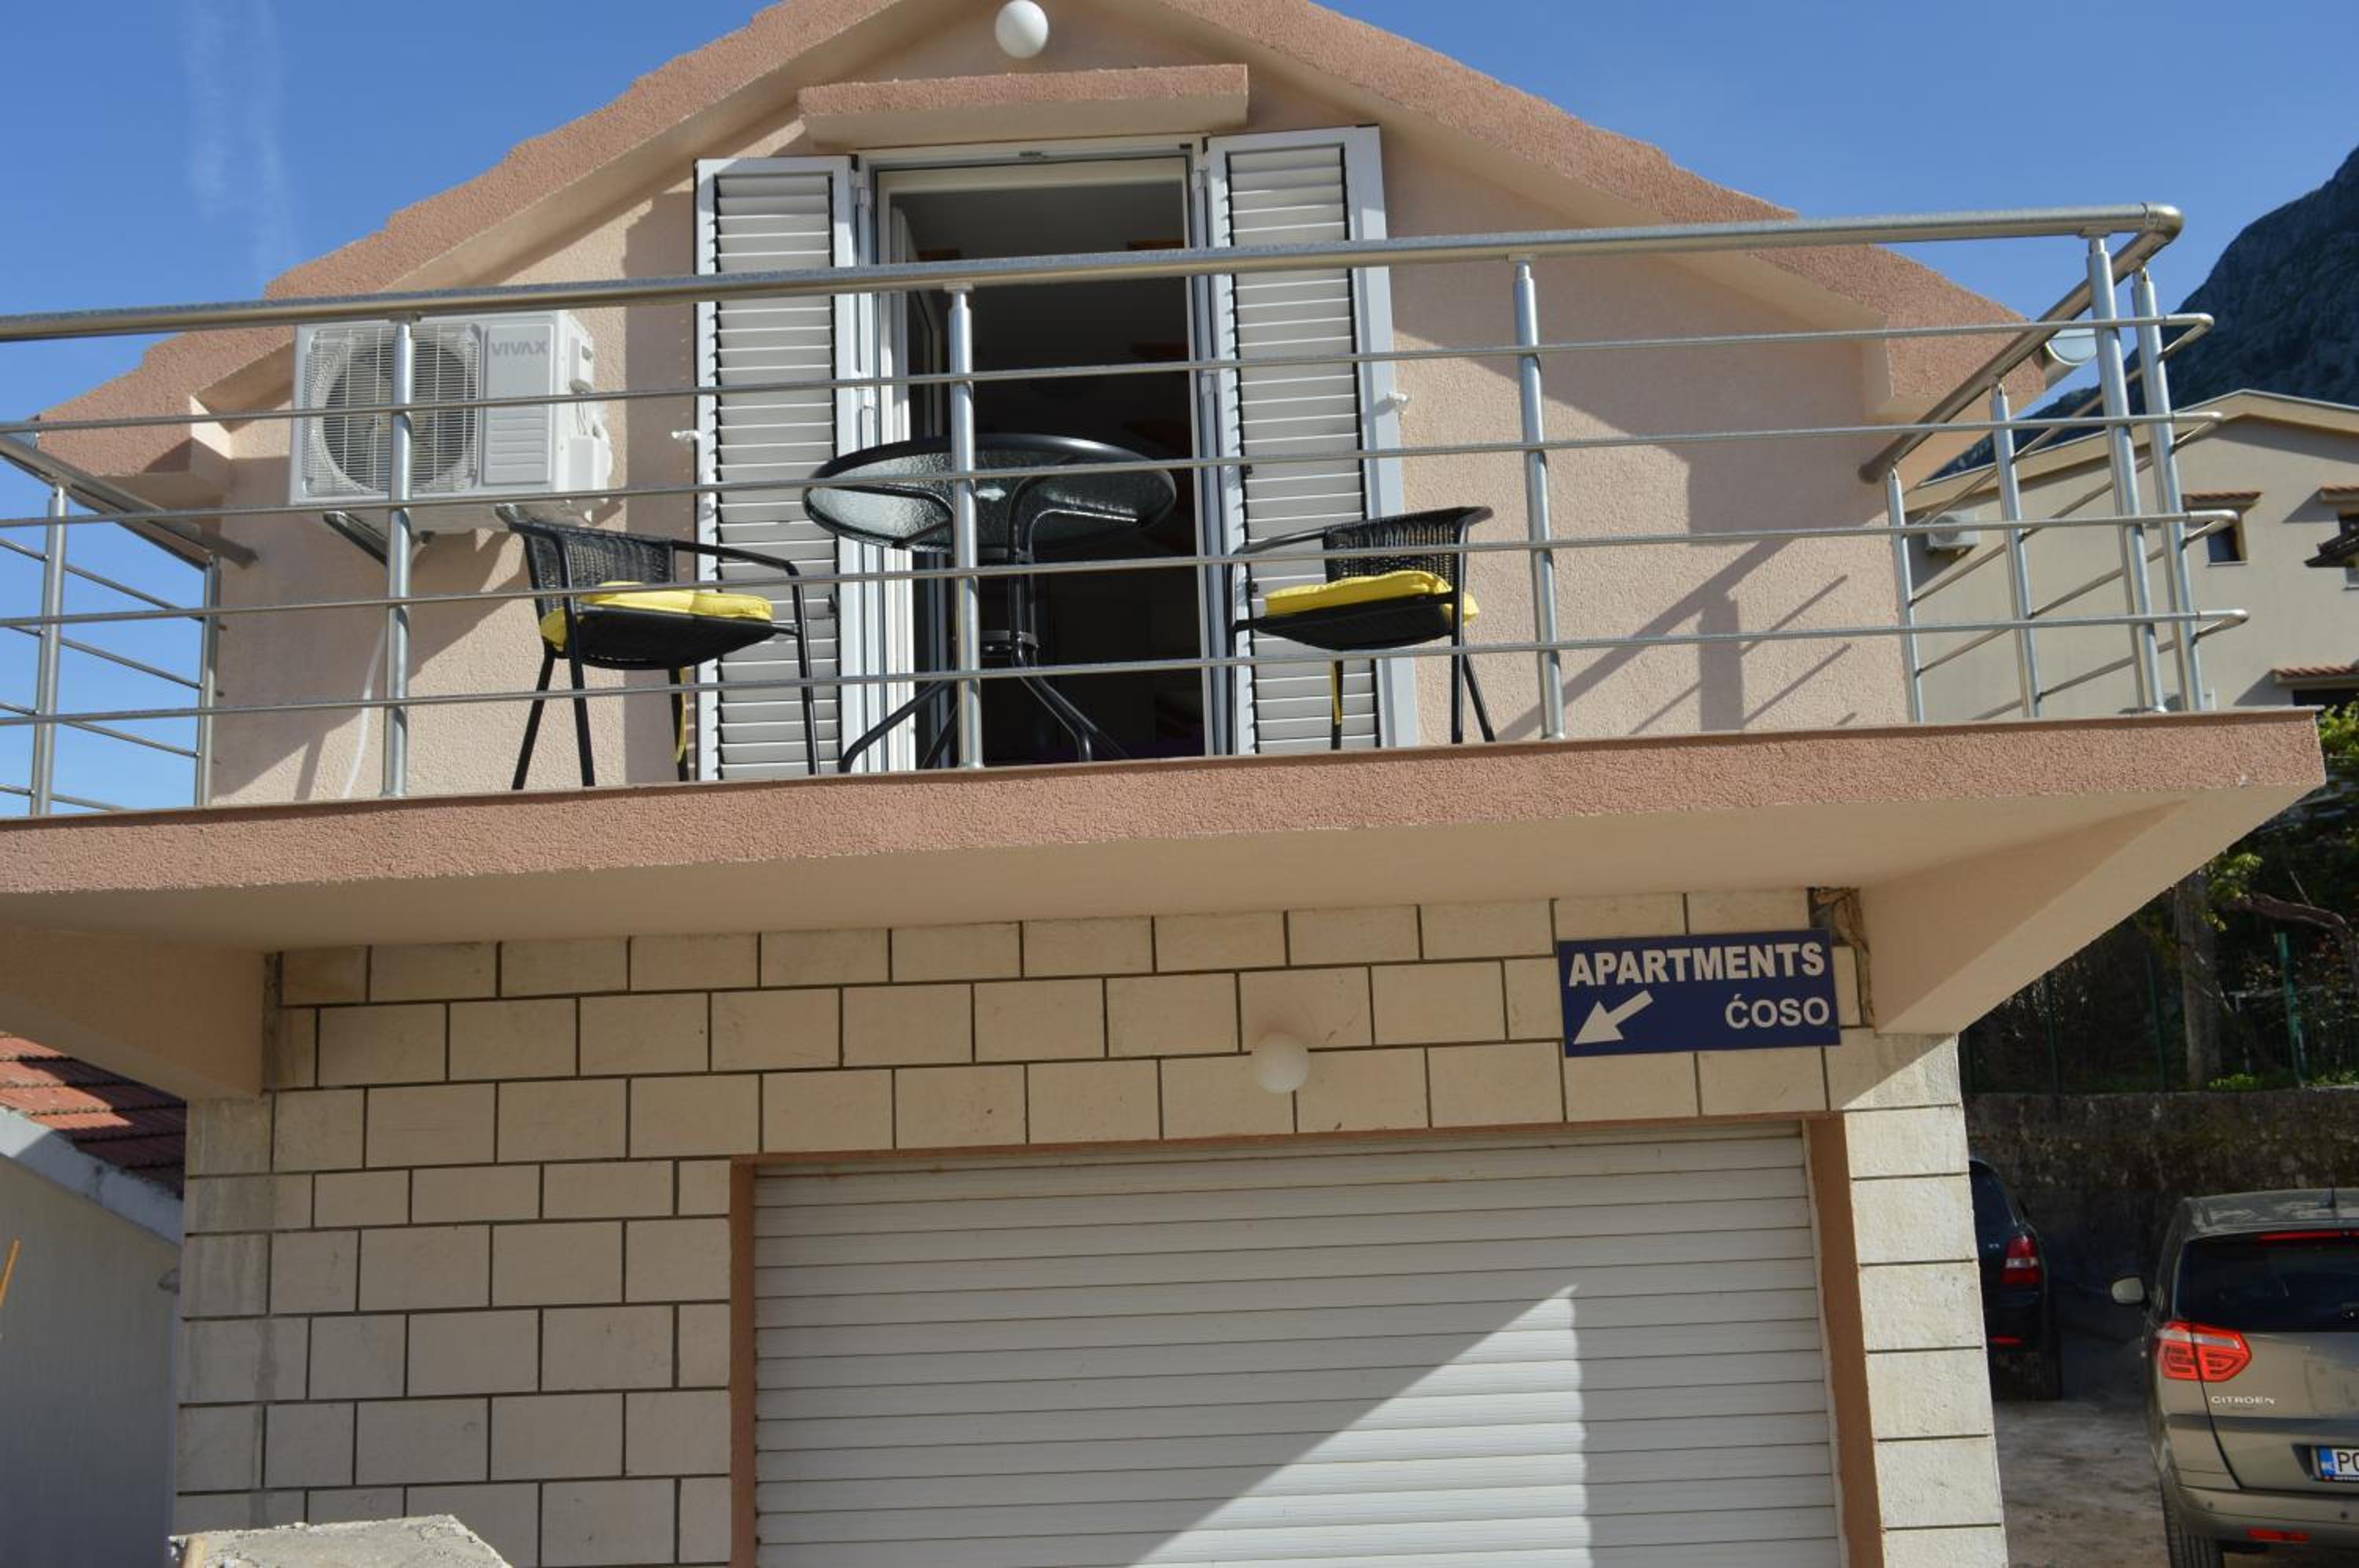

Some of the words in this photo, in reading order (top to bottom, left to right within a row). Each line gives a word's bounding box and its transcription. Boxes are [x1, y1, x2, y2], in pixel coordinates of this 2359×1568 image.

[491, 340, 548, 356] VIVAX
[1569, 941, 1825, 987] APARTMENTS
[1724, 994, 1830, 1029] ĆOSO
